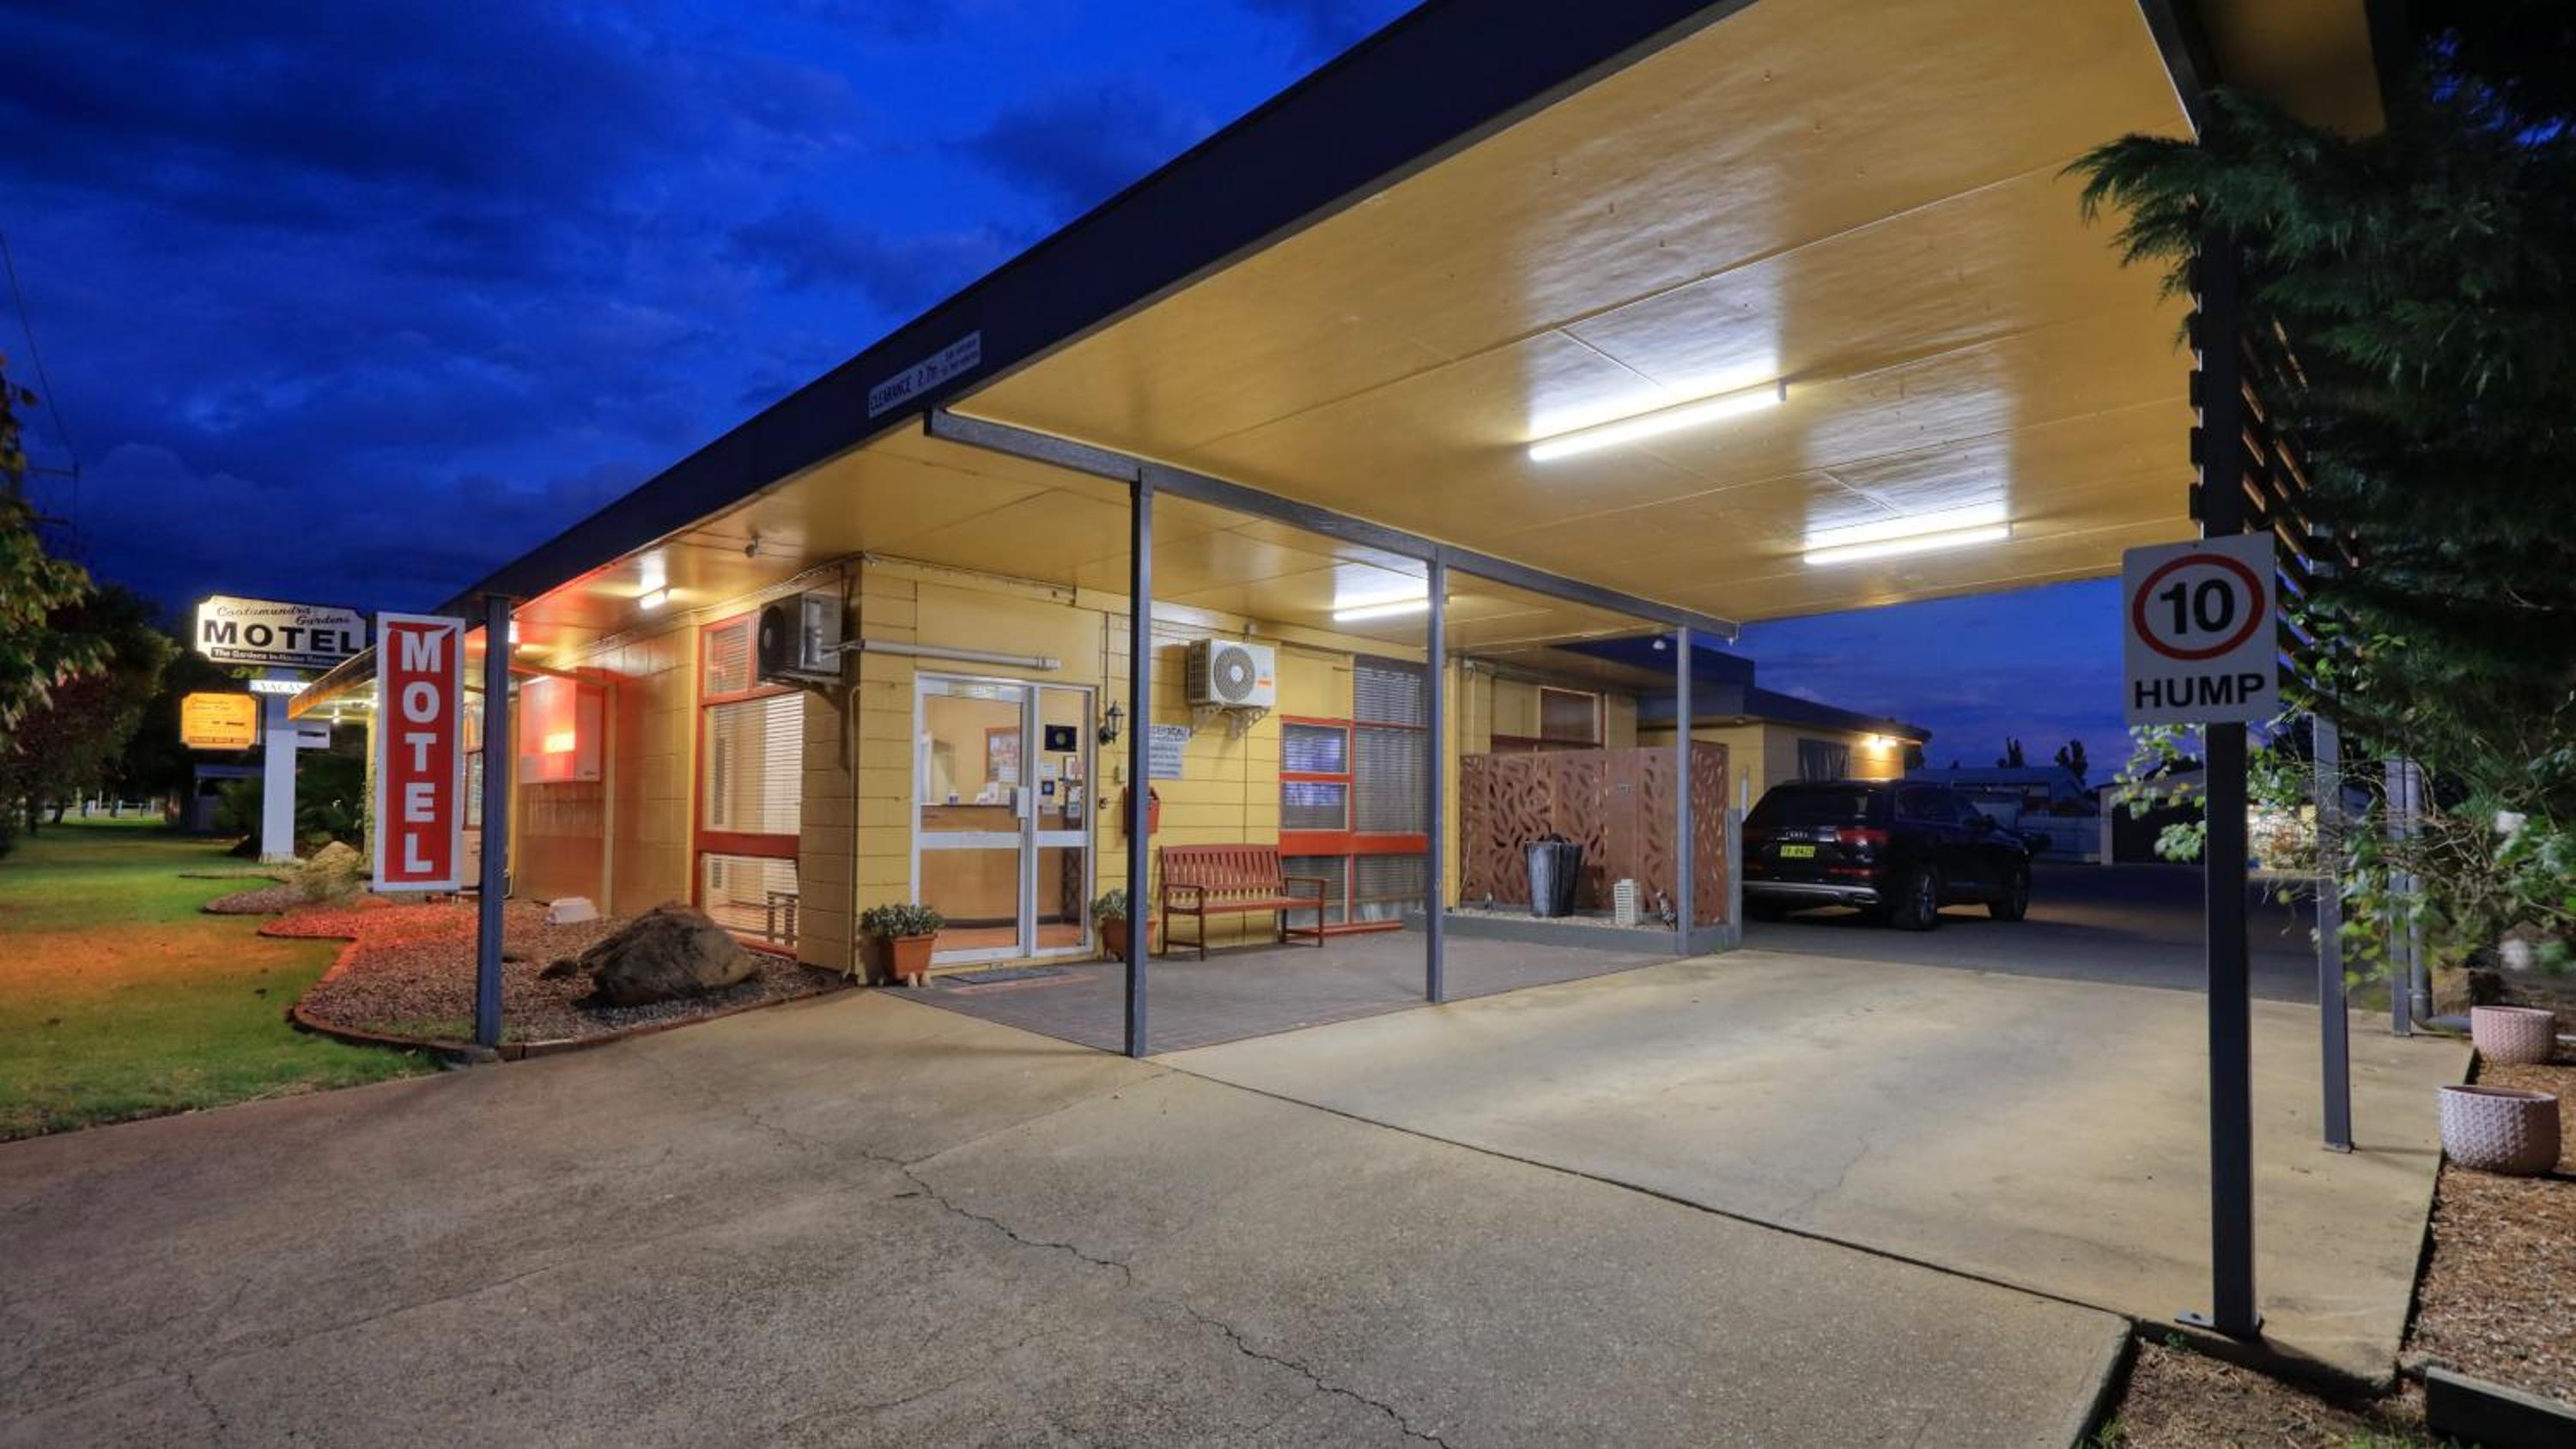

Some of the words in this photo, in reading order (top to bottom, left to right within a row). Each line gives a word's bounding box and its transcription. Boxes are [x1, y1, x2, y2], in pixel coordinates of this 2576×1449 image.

[295, 615, 351, 626] Gardens
[2160, 578, 2235, 634] 10
[204, 619, 361, 654] MOTEL
[215, 649, 230, 658] The
[2135, 673, 2265, 709] HUMP
[400, 631, 441, 874] MOTEL
